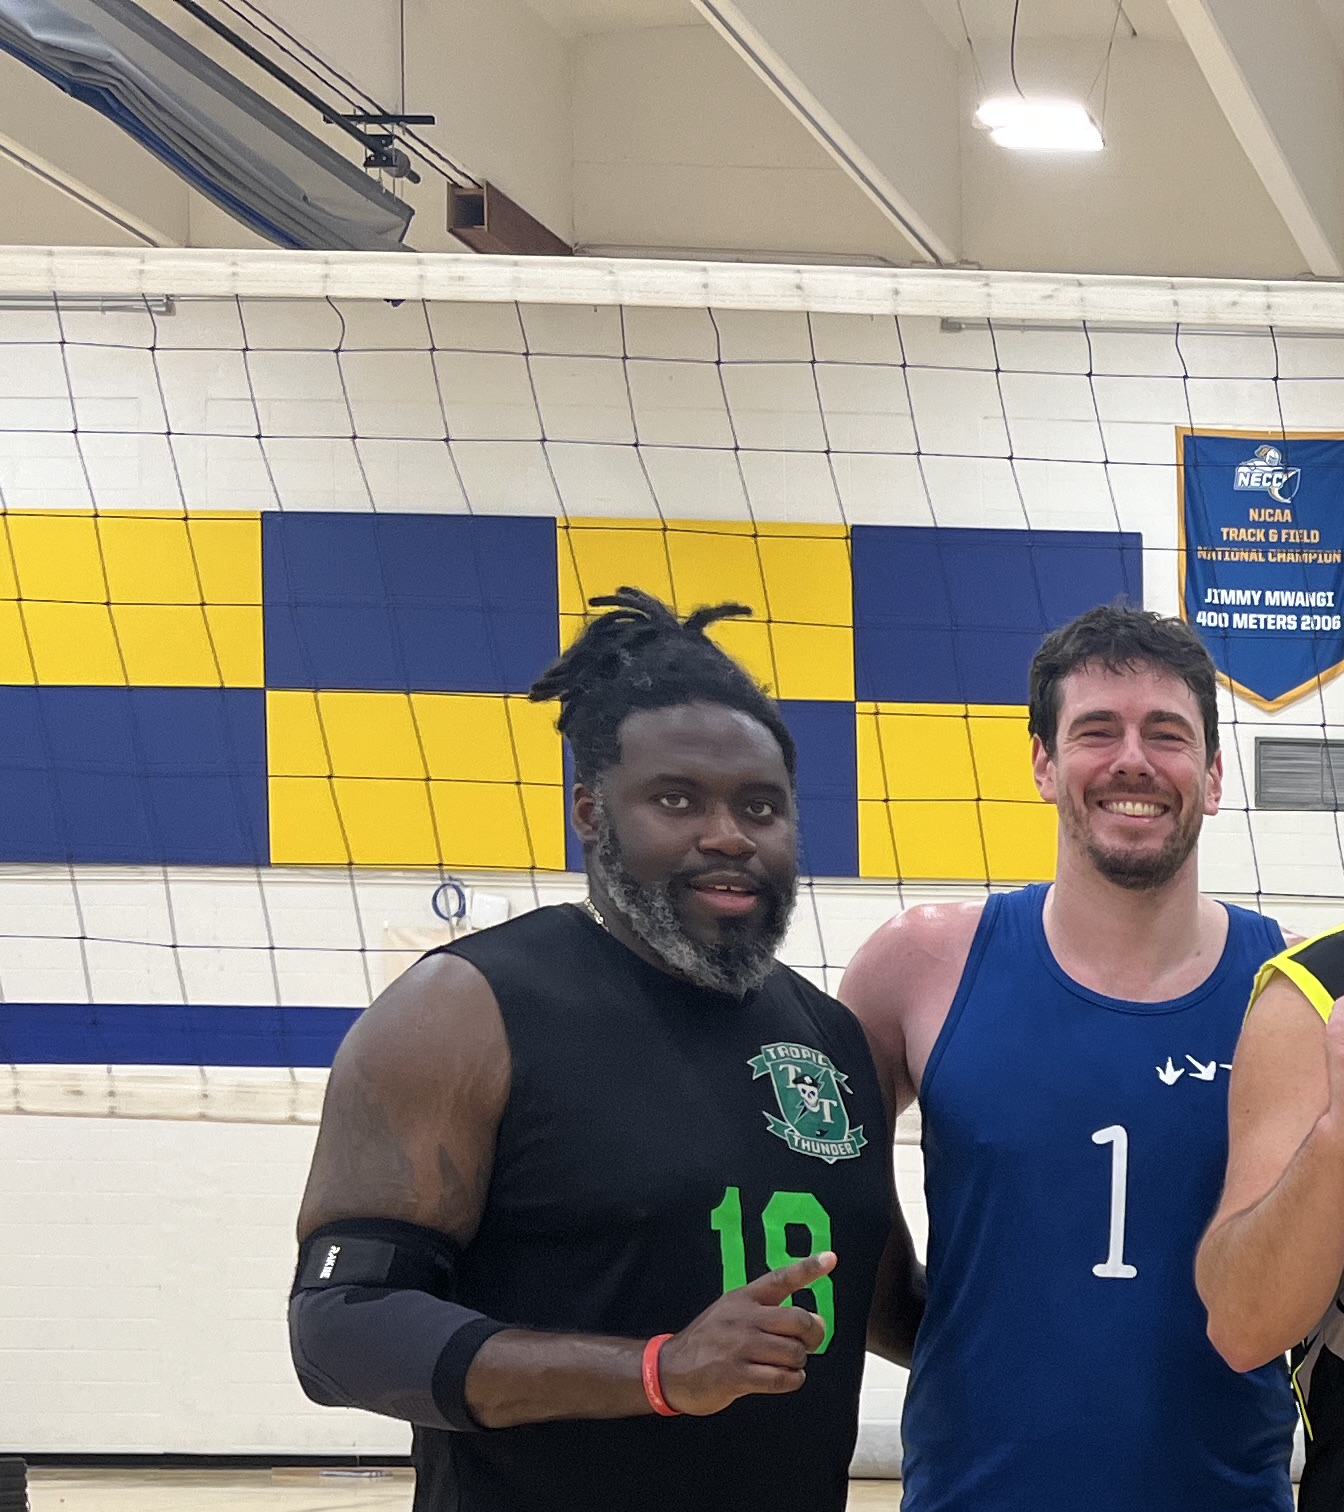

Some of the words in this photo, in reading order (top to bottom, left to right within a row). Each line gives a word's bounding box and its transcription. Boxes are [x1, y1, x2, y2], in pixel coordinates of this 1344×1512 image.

[1236, 472, 1285, 487] NECC
[1249, 508, 1292, 522] NJCAA
[1221, 528, 1265, 541] TRACK
[1281, 529, 1319, 543] FIELD
[1198, 547, 1263, 562] NATIONAL
[1268, 549, 1341, 564] CHAMPION
[1205, 588, 1262, 605] JIMMY
[1265, 591, 1334, 607] MWANGI
[1196, 611, 1229, 627] 400
[1233, 613, 1297, 630] METERS
[1301, 615, 1341, 630] 2006
[766, 1046, 828, 1066] TROPIC
[793, 1135, 854, 1154] THUNDER
[1092, 1125, 1137, 1278] 1
[711, 1186, 834, 1355] 18
